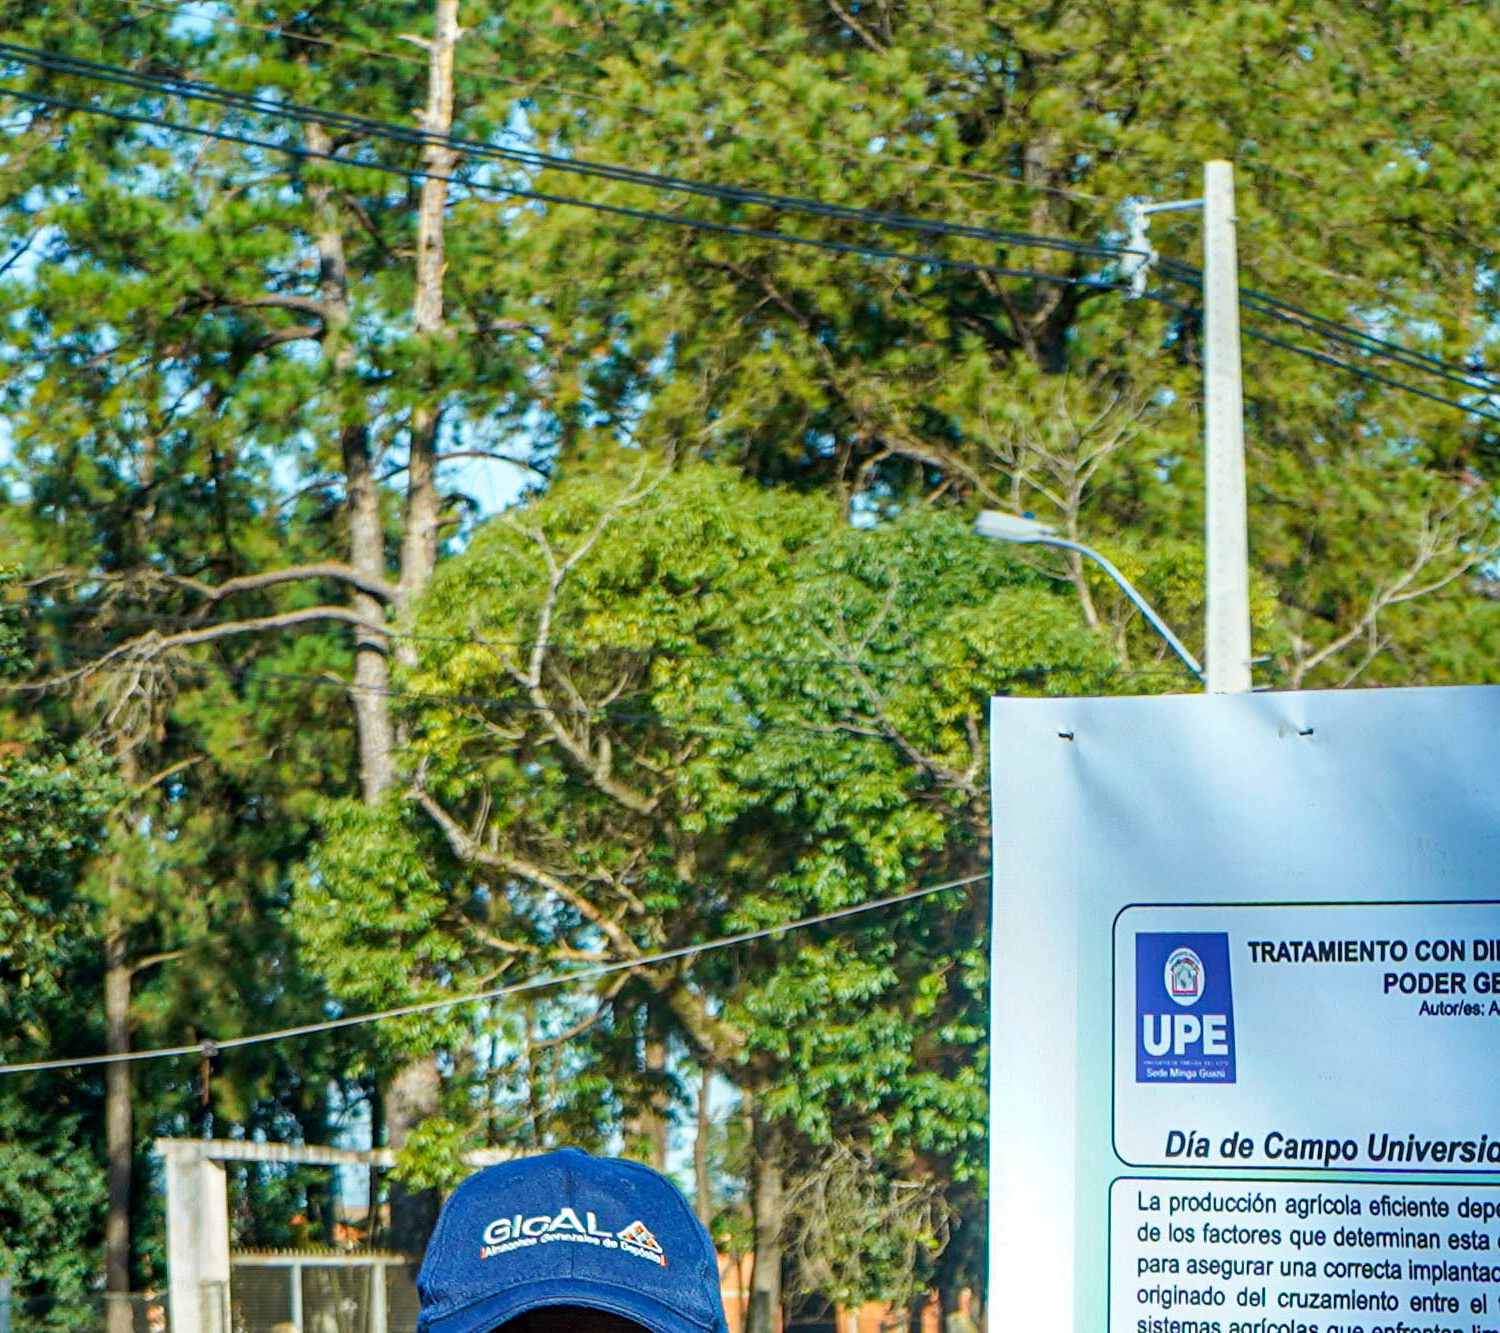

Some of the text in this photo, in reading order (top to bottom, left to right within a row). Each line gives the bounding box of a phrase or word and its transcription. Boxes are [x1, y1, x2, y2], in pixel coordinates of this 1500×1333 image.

[1248, 940, 1407, 963] TRATAMIENTO
[1415, 940, 1465, 961] CON
[1384, 972, 1466, 994] PODER
[1143, 1014, 1229, 1056] UPE
[1165, 1130, 1210, 1158] Día
[1220, 1131, 1254, 1158] de
[1264, 1131, 1358, 1168] Campo
[1138, 1191, 1160, 1211] La
[1170, 1192, 1276, 1216] producción
[1285, 1194, 1361, 1219] agrícola
[1369, 1195, 1449, 1217] eficiente
